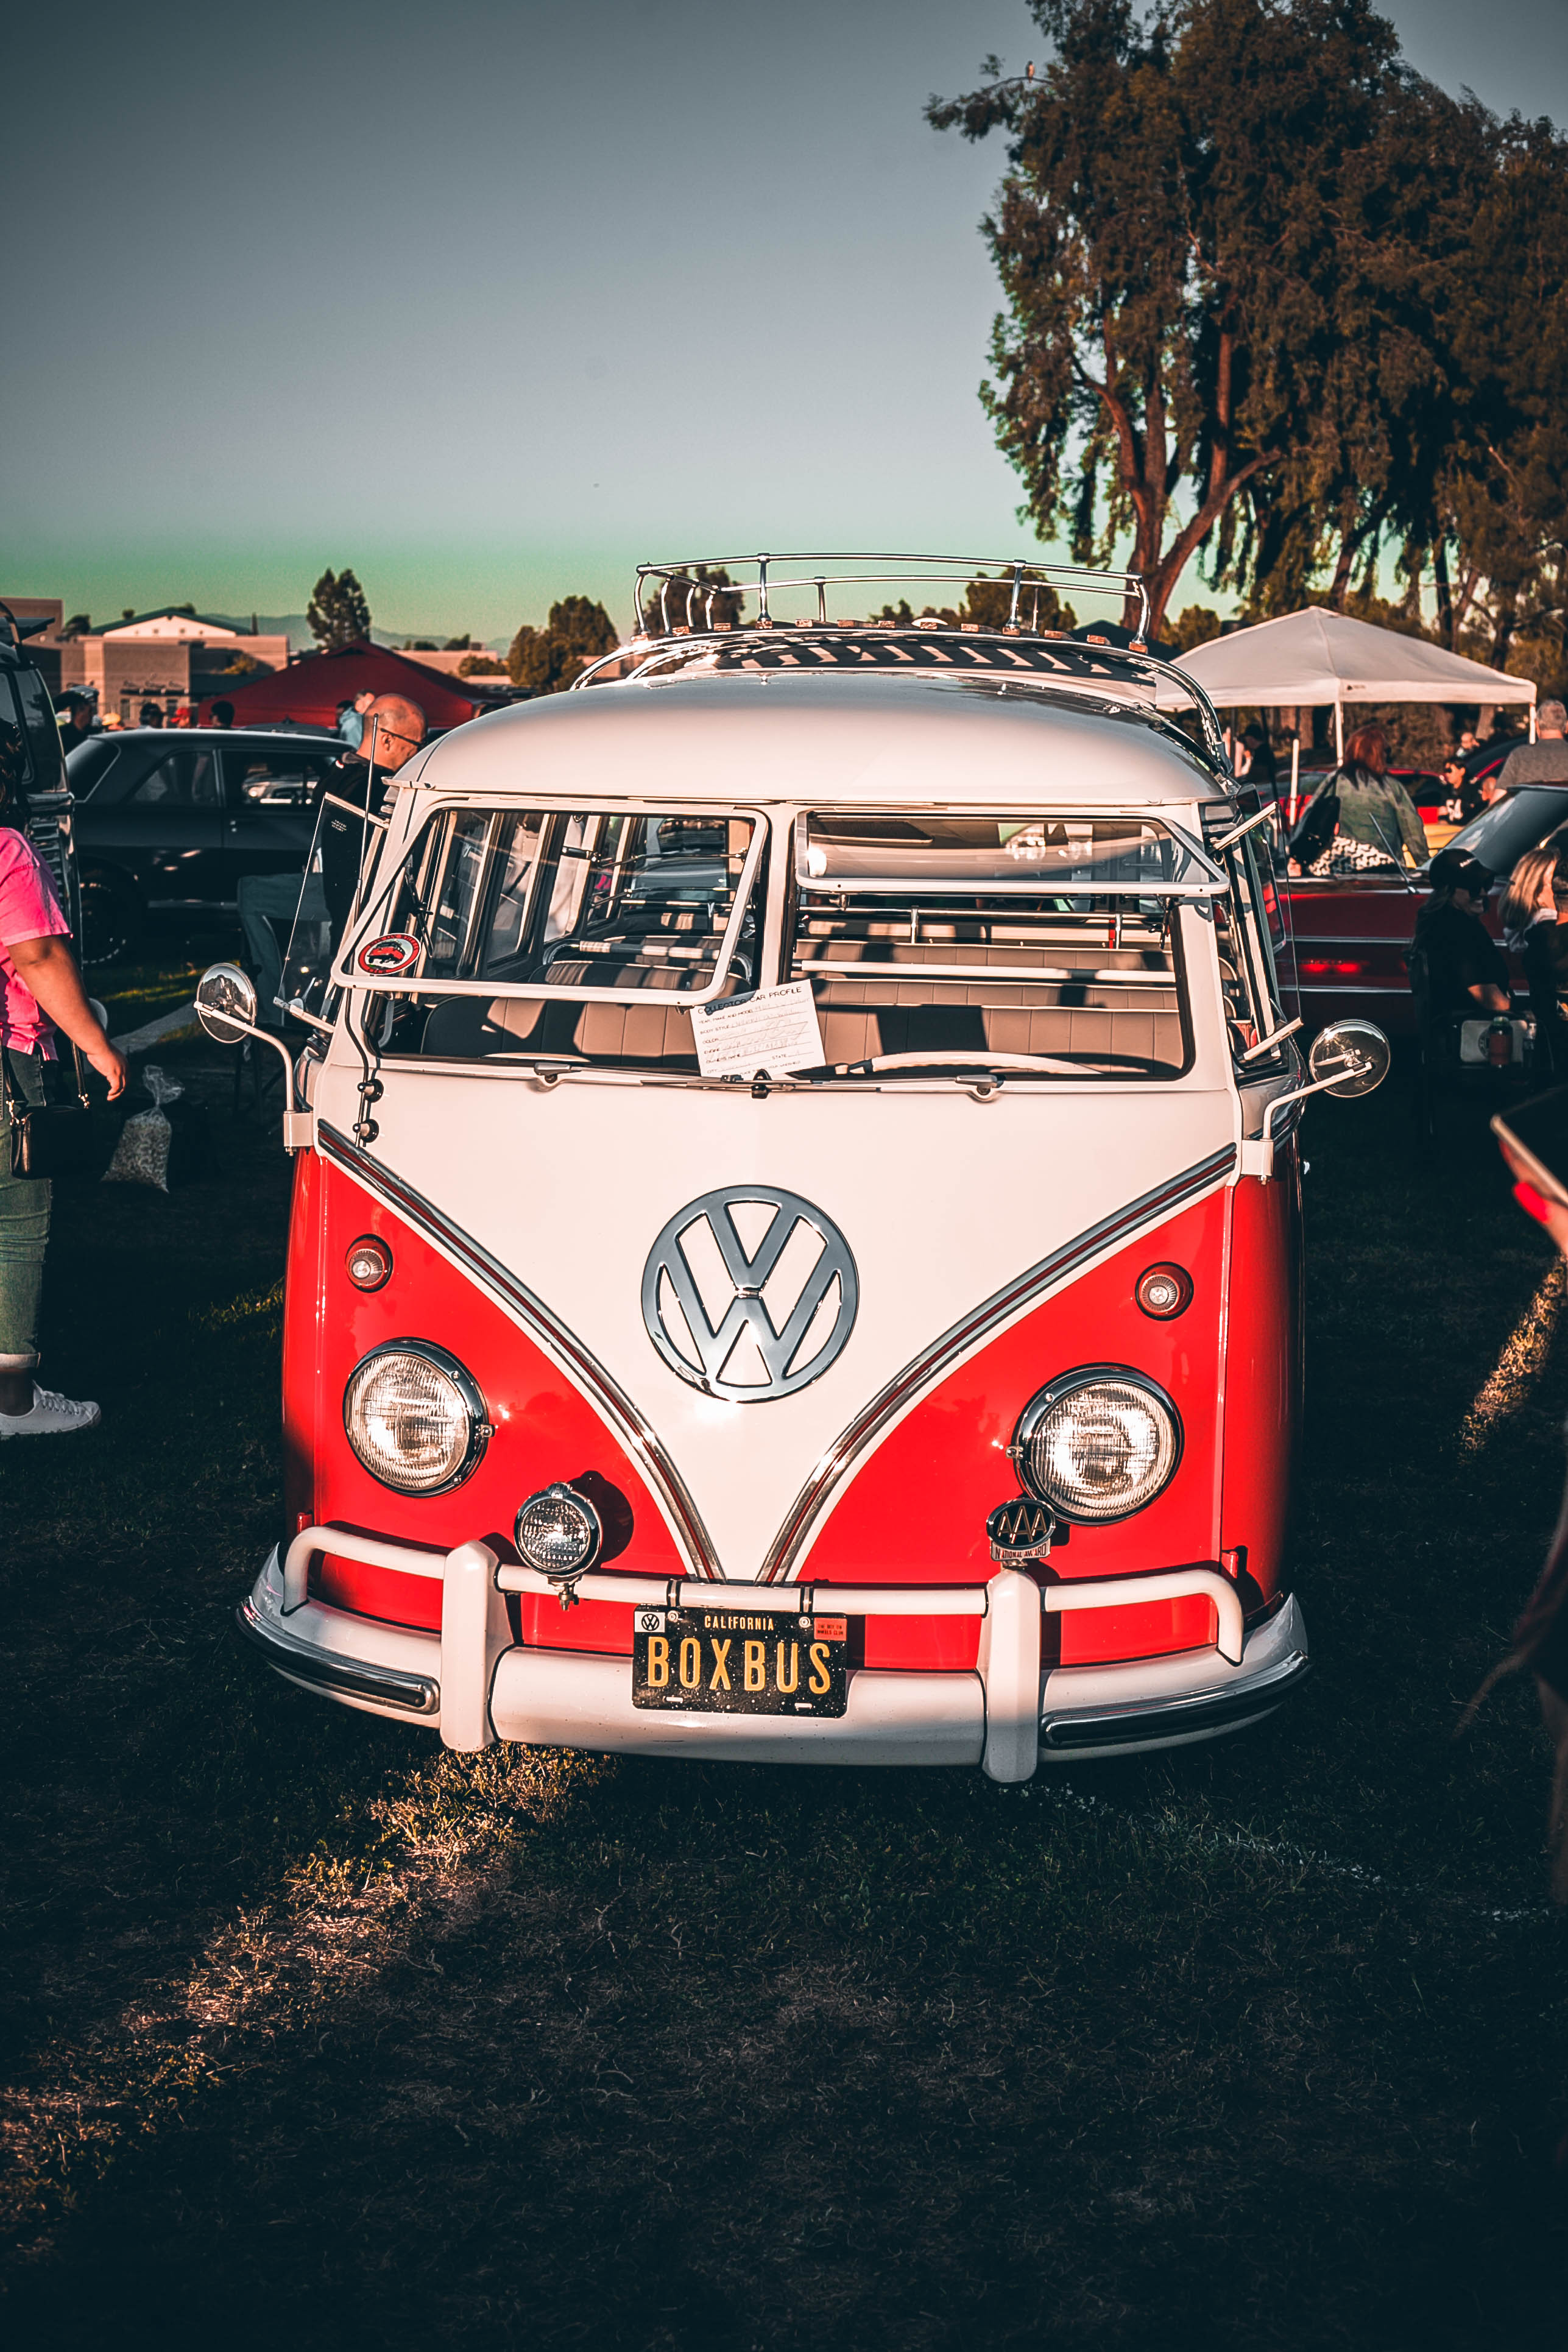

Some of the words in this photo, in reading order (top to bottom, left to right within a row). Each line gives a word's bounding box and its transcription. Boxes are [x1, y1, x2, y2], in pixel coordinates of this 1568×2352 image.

[698, 999, 747, 1014] COLLECTOR
[769, 986, 802, 998] PROFILE
[996, 1505, 1047, 1544] AAA
[995, 1546, 1023, 1559] NATIONAL
[1024, 1543, 1047, 1558] AWARD
[704, 1615, 774, 1631] CALIFORNIA
